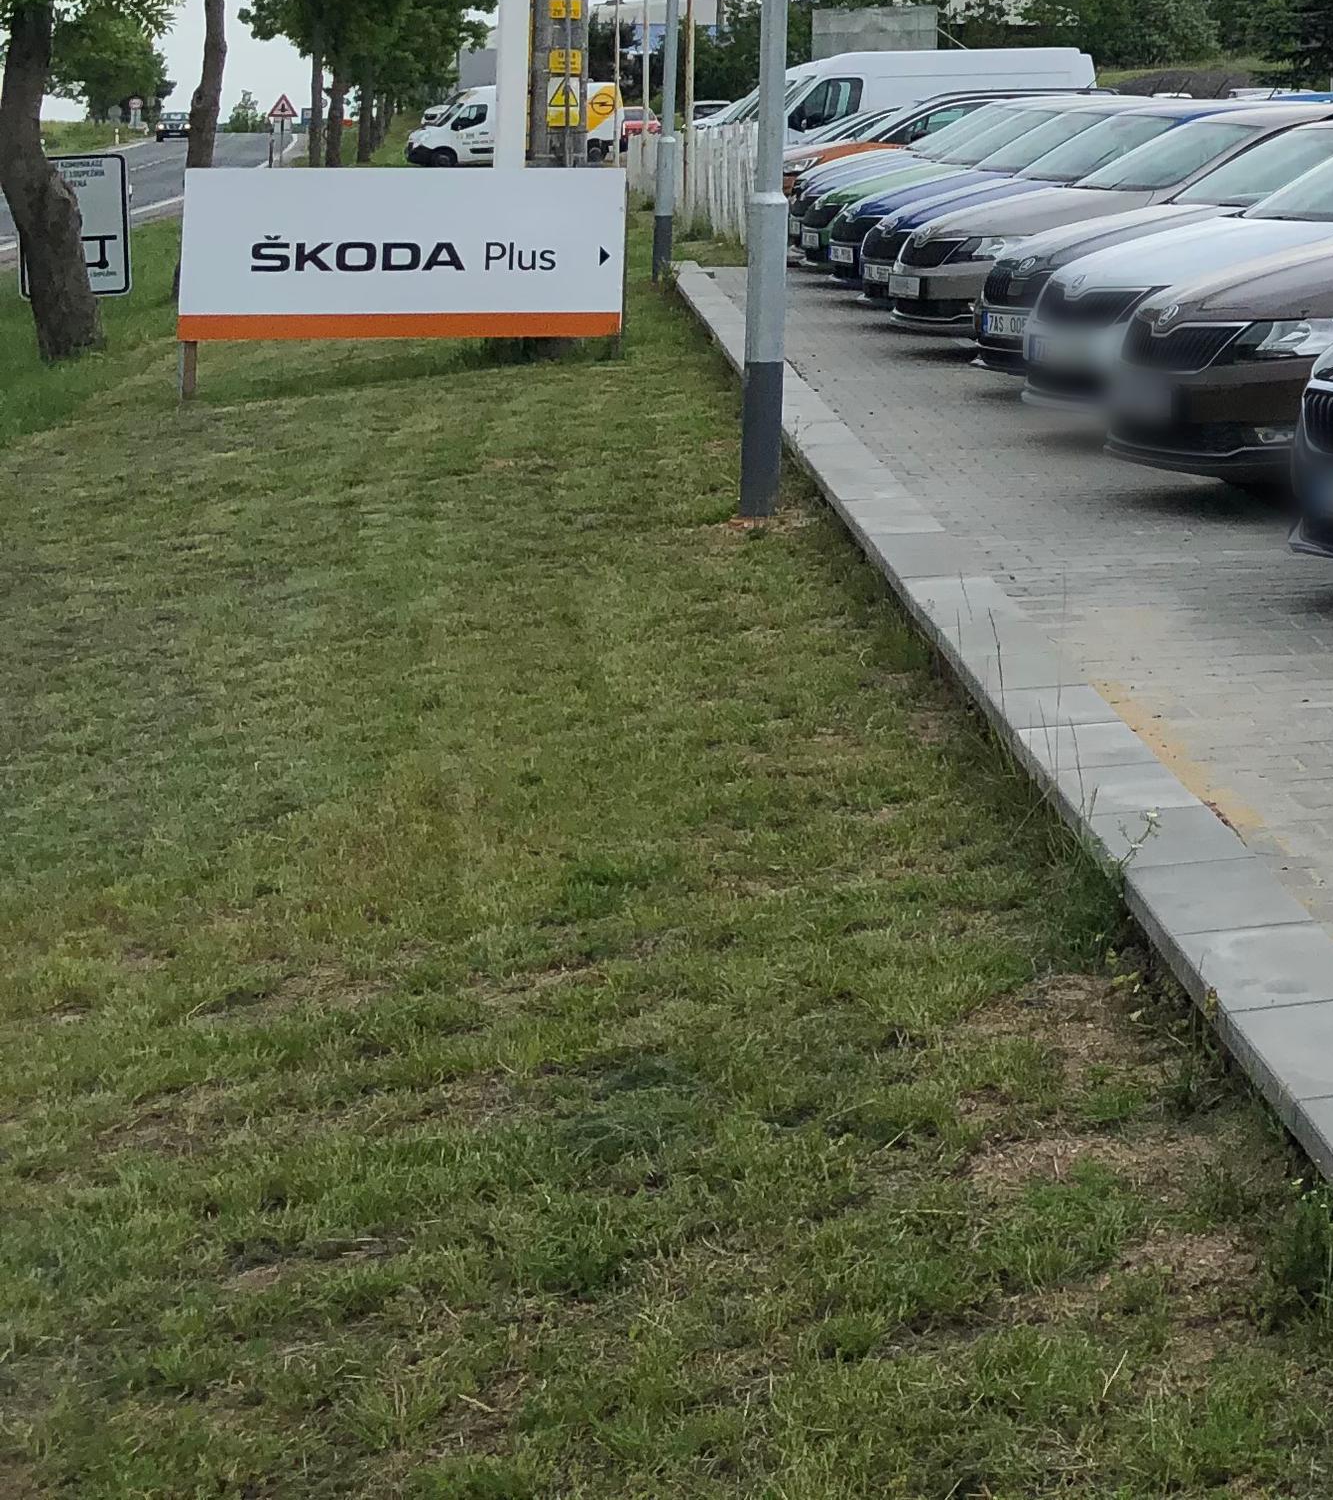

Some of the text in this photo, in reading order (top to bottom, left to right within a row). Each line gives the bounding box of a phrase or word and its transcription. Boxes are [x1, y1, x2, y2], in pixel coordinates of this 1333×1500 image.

[250, 235, 557, 272] ŠKODA Plus
[989, 314, 1004, 333] 7AS
